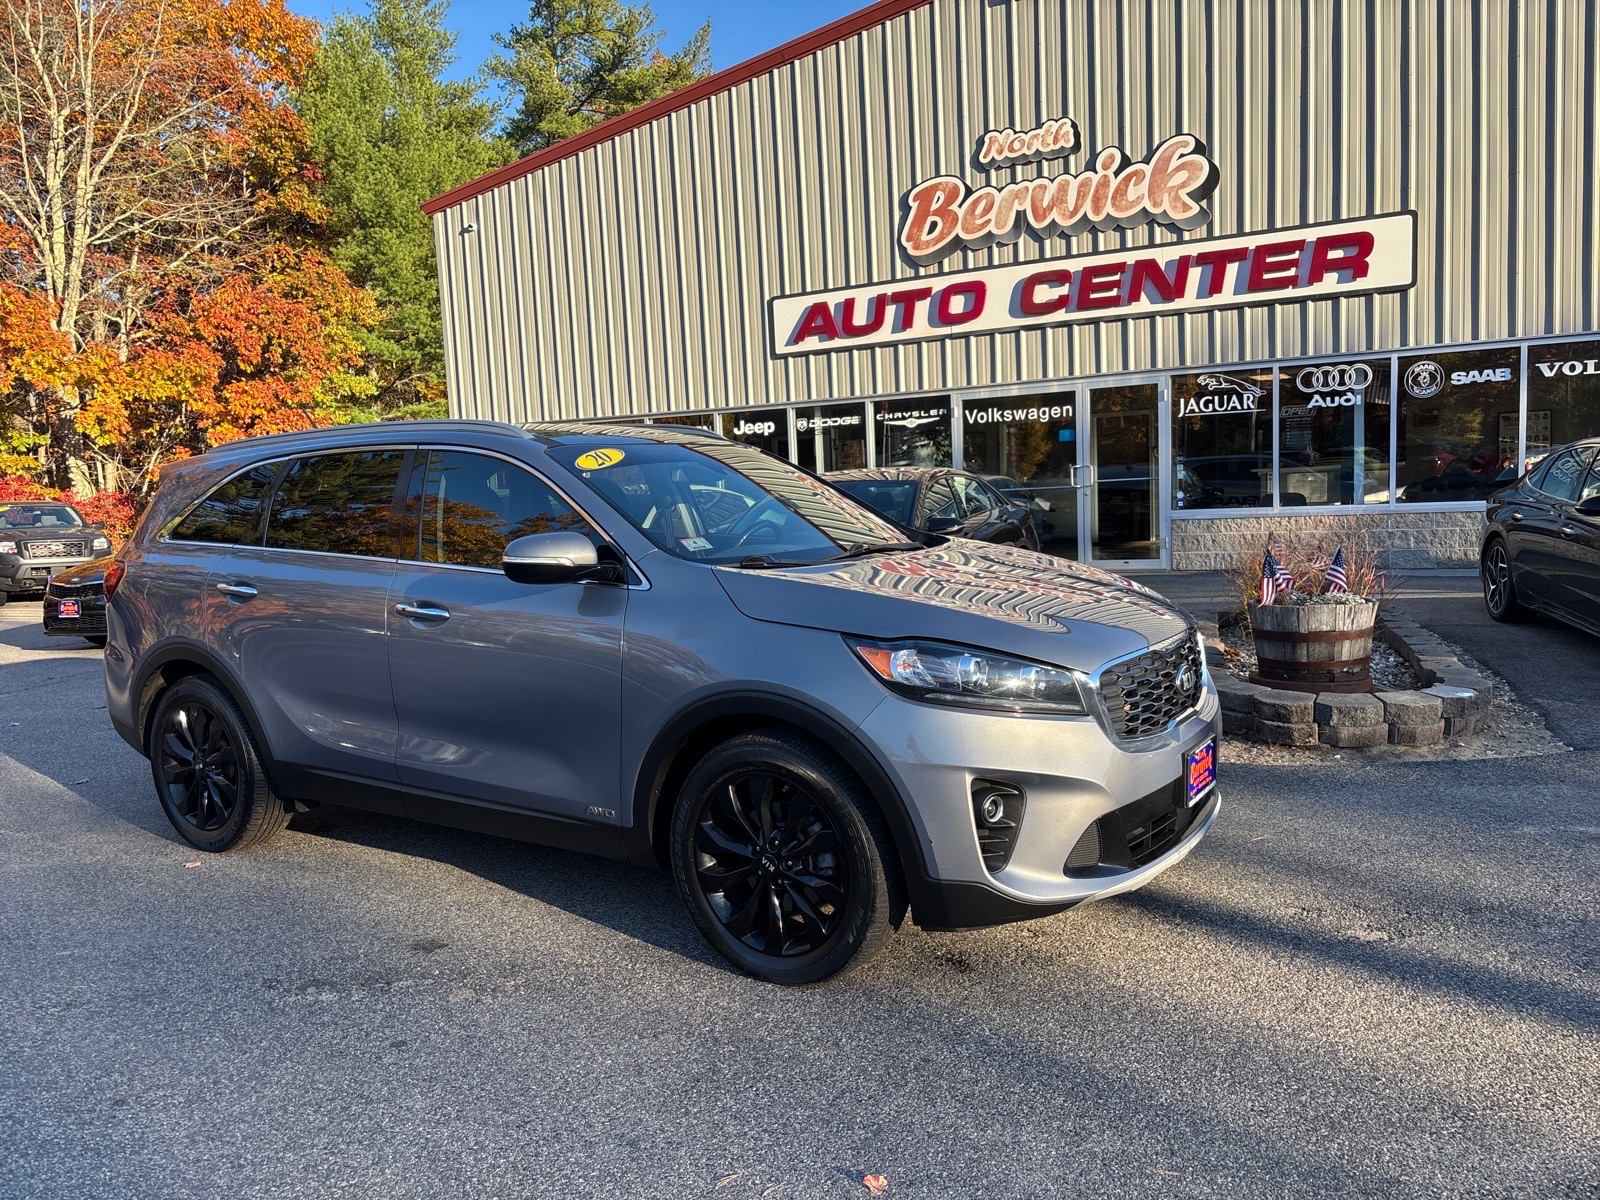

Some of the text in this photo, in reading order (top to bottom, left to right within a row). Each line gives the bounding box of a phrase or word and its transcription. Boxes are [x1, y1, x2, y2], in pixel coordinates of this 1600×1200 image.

[980, 118, 1074, 163] North
[902, 133, 1209, 256] Berwick
[792, 231, 1375, 346] AUTO CENTER
[1450, 367, 1512, 386] SAAB
[1535, 359, 1600, 377] VOL
[1178, 393, 1255, 417] JAGUAR
[1307, 392, 1361, 408] Audi
[876, 409, 947, 420] CHRYSLER
[965, 405, 1073, 424] Volkswagen
[1282, 406, 1315, 416] OPEN
[733, 420, 775, 436] Jeep
[808, 415, 862, 428] DODGE
[586, 451, 612, 467] 20
[588, 805, 615, 818] AWD
[762, 855, 775, 872] KIA
